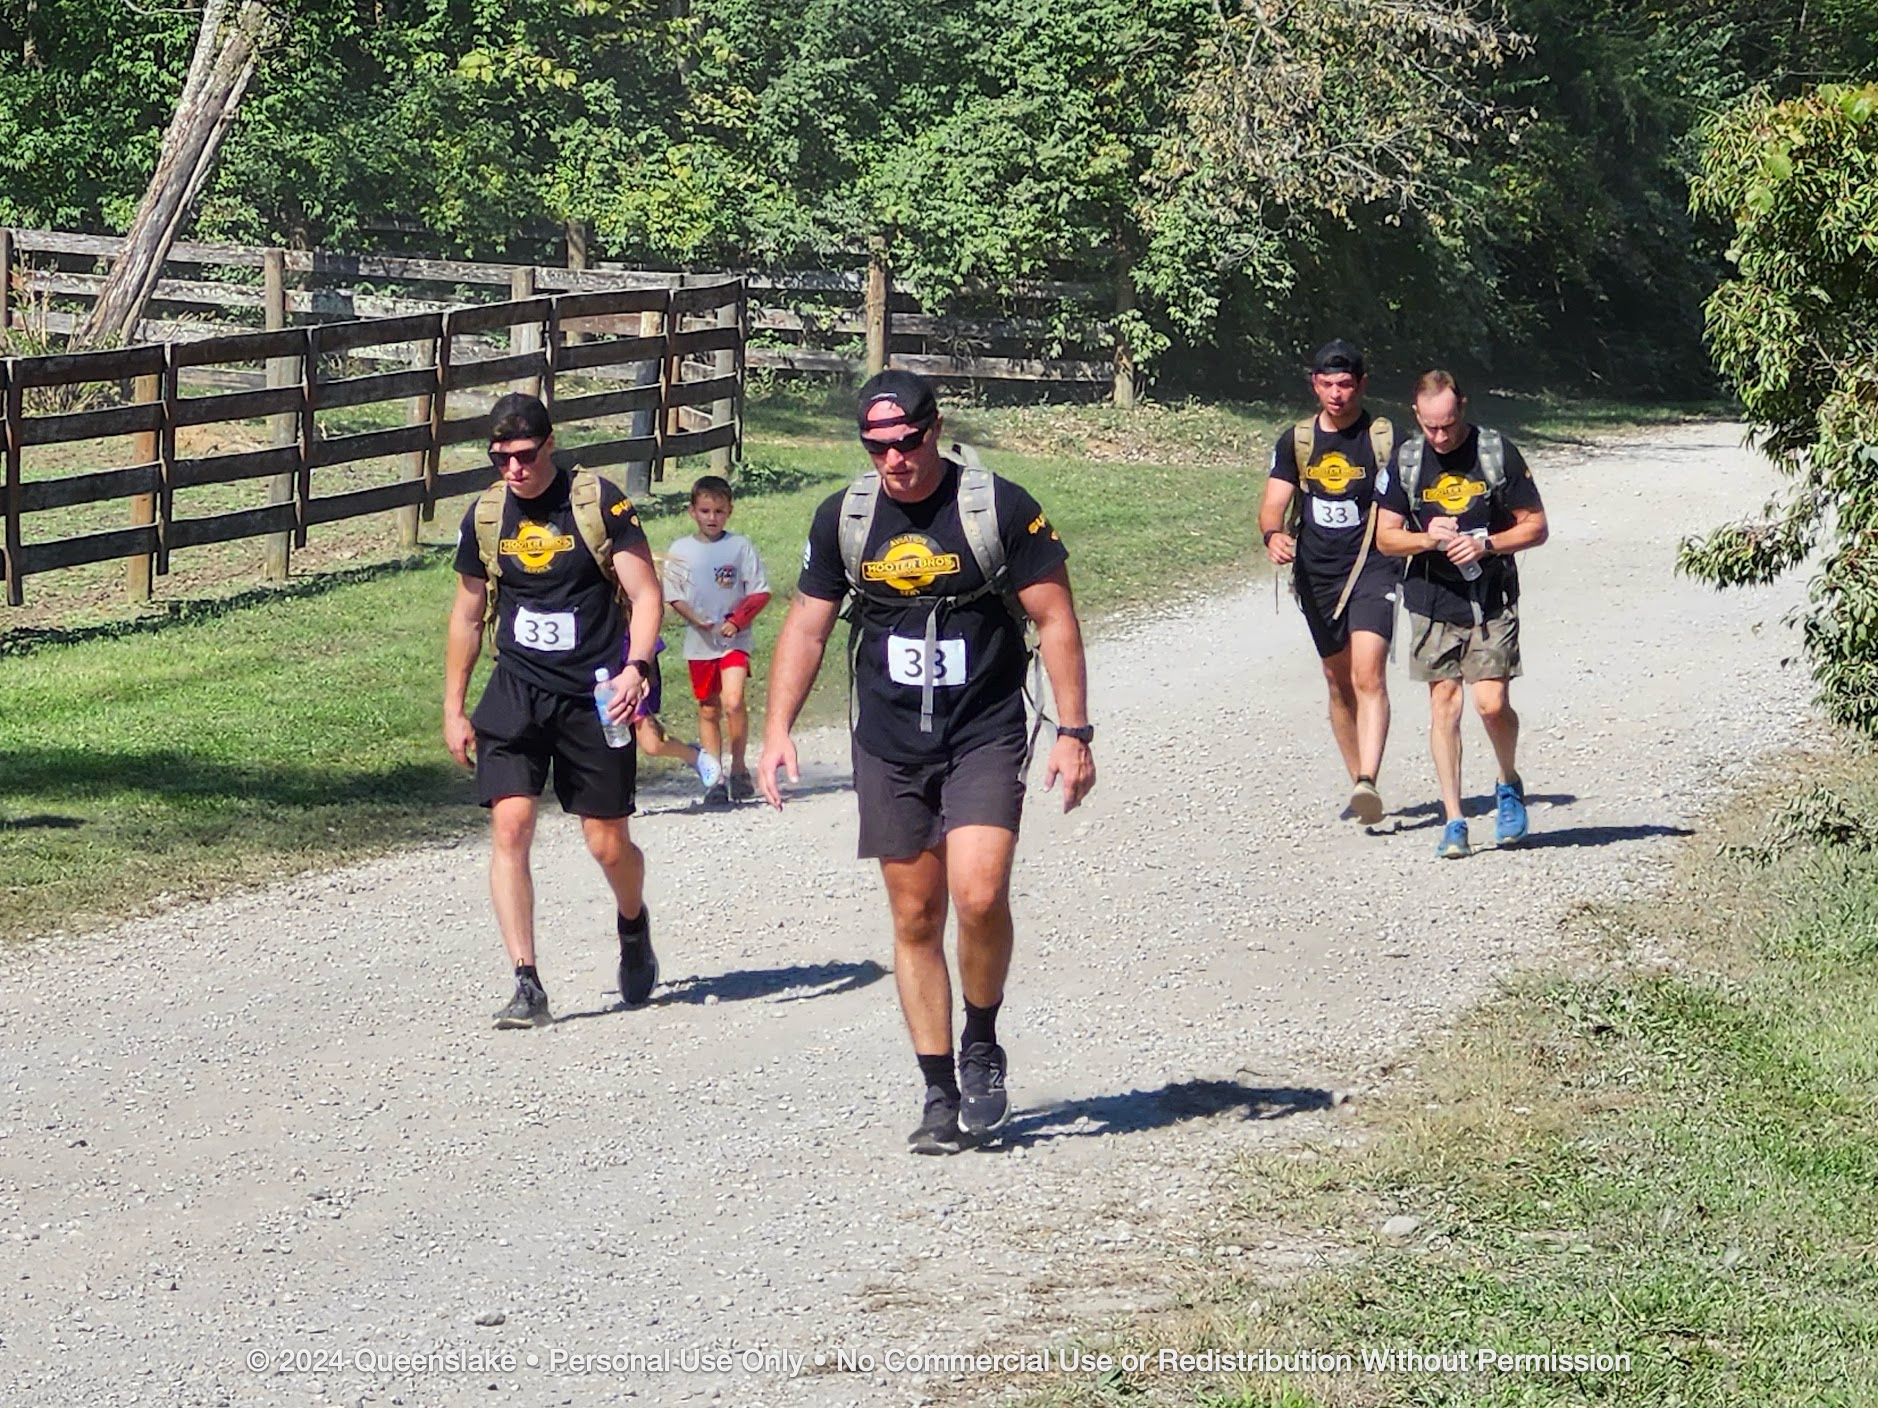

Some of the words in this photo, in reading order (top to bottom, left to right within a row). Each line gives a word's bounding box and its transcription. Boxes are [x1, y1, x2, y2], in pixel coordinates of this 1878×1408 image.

[1322, 506, 1348, 523] 33
[525, 619, 560, 645] 33
[904, 648, 949, 680] 33
